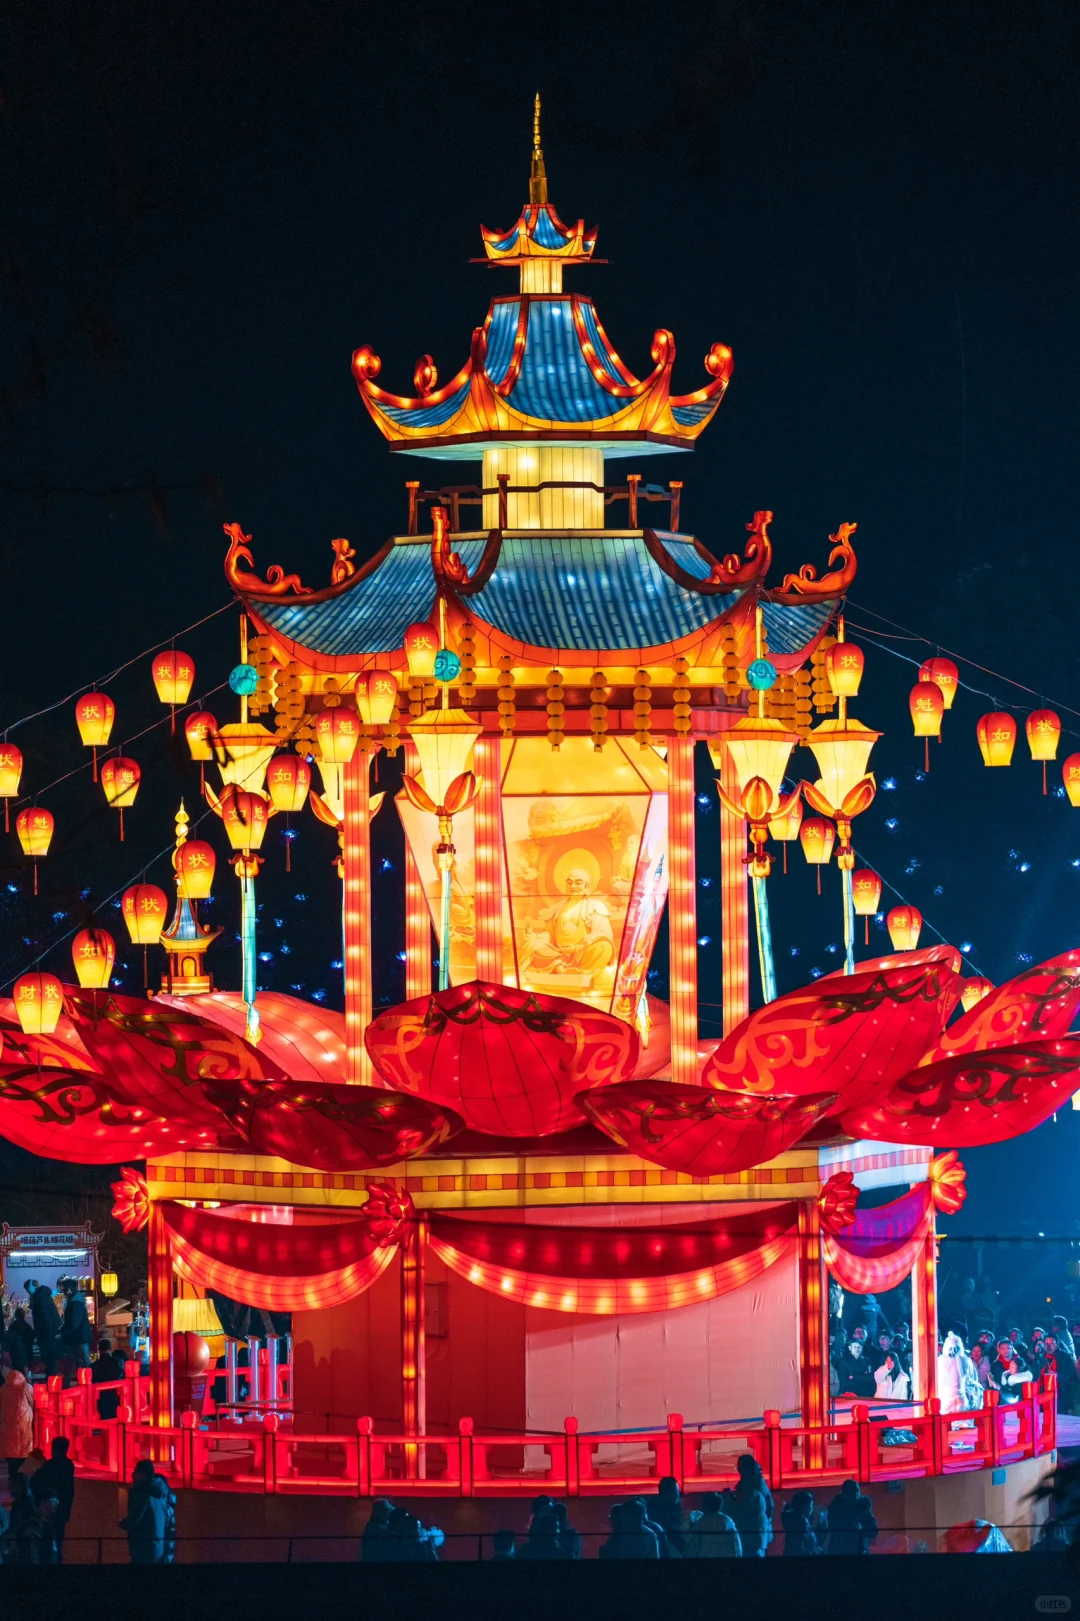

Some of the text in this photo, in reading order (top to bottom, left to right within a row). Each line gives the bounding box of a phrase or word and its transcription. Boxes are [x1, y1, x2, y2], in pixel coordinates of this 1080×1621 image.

[413, 637, 432, 650] 状
[841, 656, 859, 669] 状
[158, 666, 172, 679] 状
[376, 681, 393, 694] 状
[82, 706, 100, 719] 状
[992, 729, 1010, 741] 如
[274, 769, 291, 782] 如
[189, 854, 209, 867] 状
[856, 880, 871, 890] 如
[141, 898, 160, 911] 状
